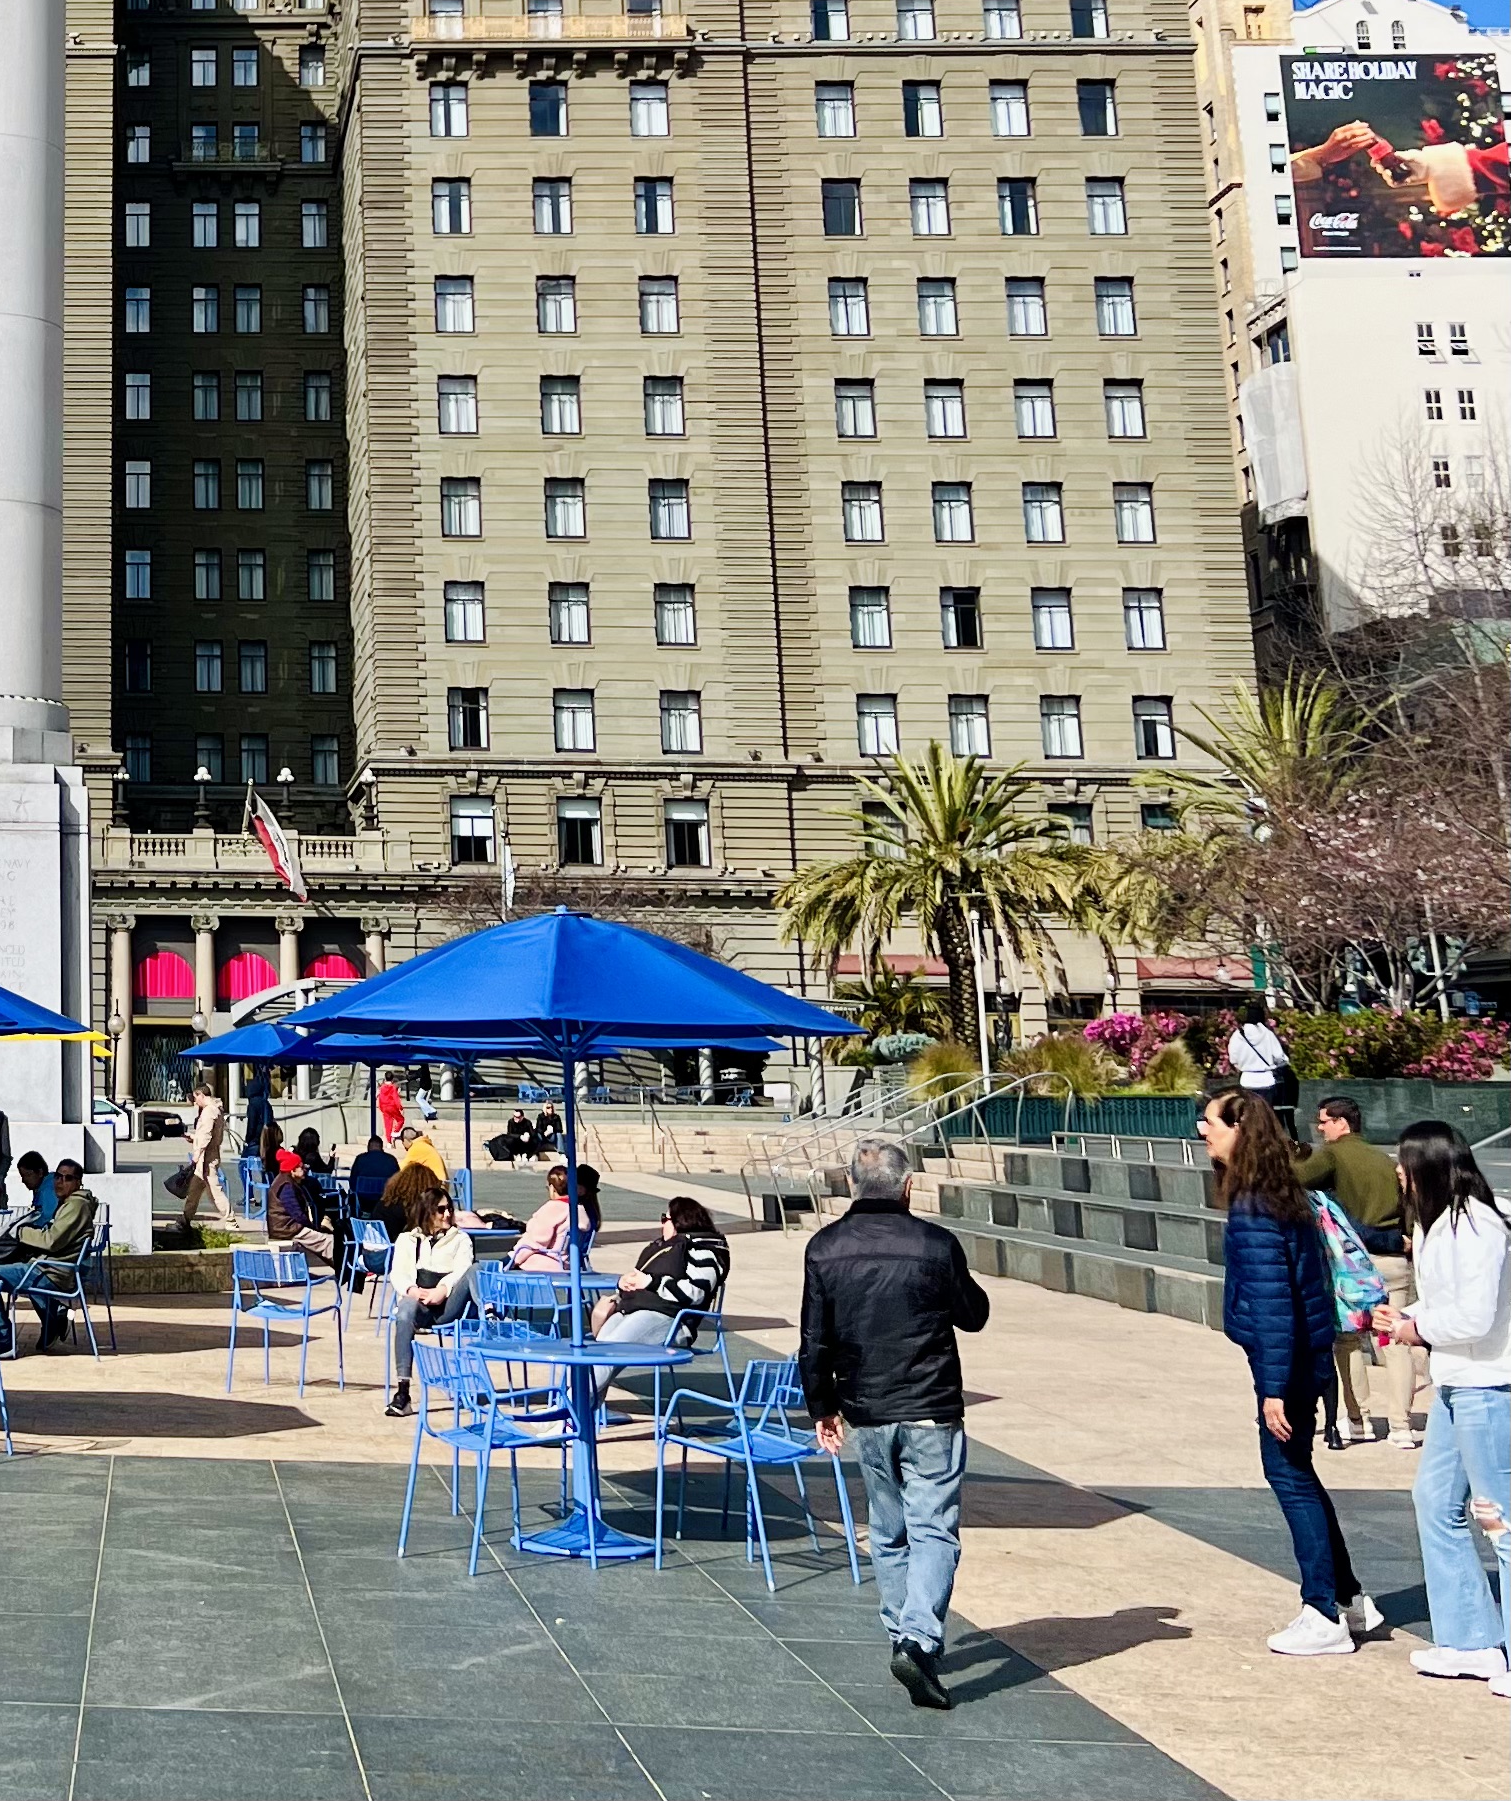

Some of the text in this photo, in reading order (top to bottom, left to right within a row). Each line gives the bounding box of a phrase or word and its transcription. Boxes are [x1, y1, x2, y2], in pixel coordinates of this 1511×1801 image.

[1291, 60, 1417, 80] SHARE HOLIDAY
[1293, 81, 1354, 100] MAGIC
[3, 859, 31, 869] NAVY
